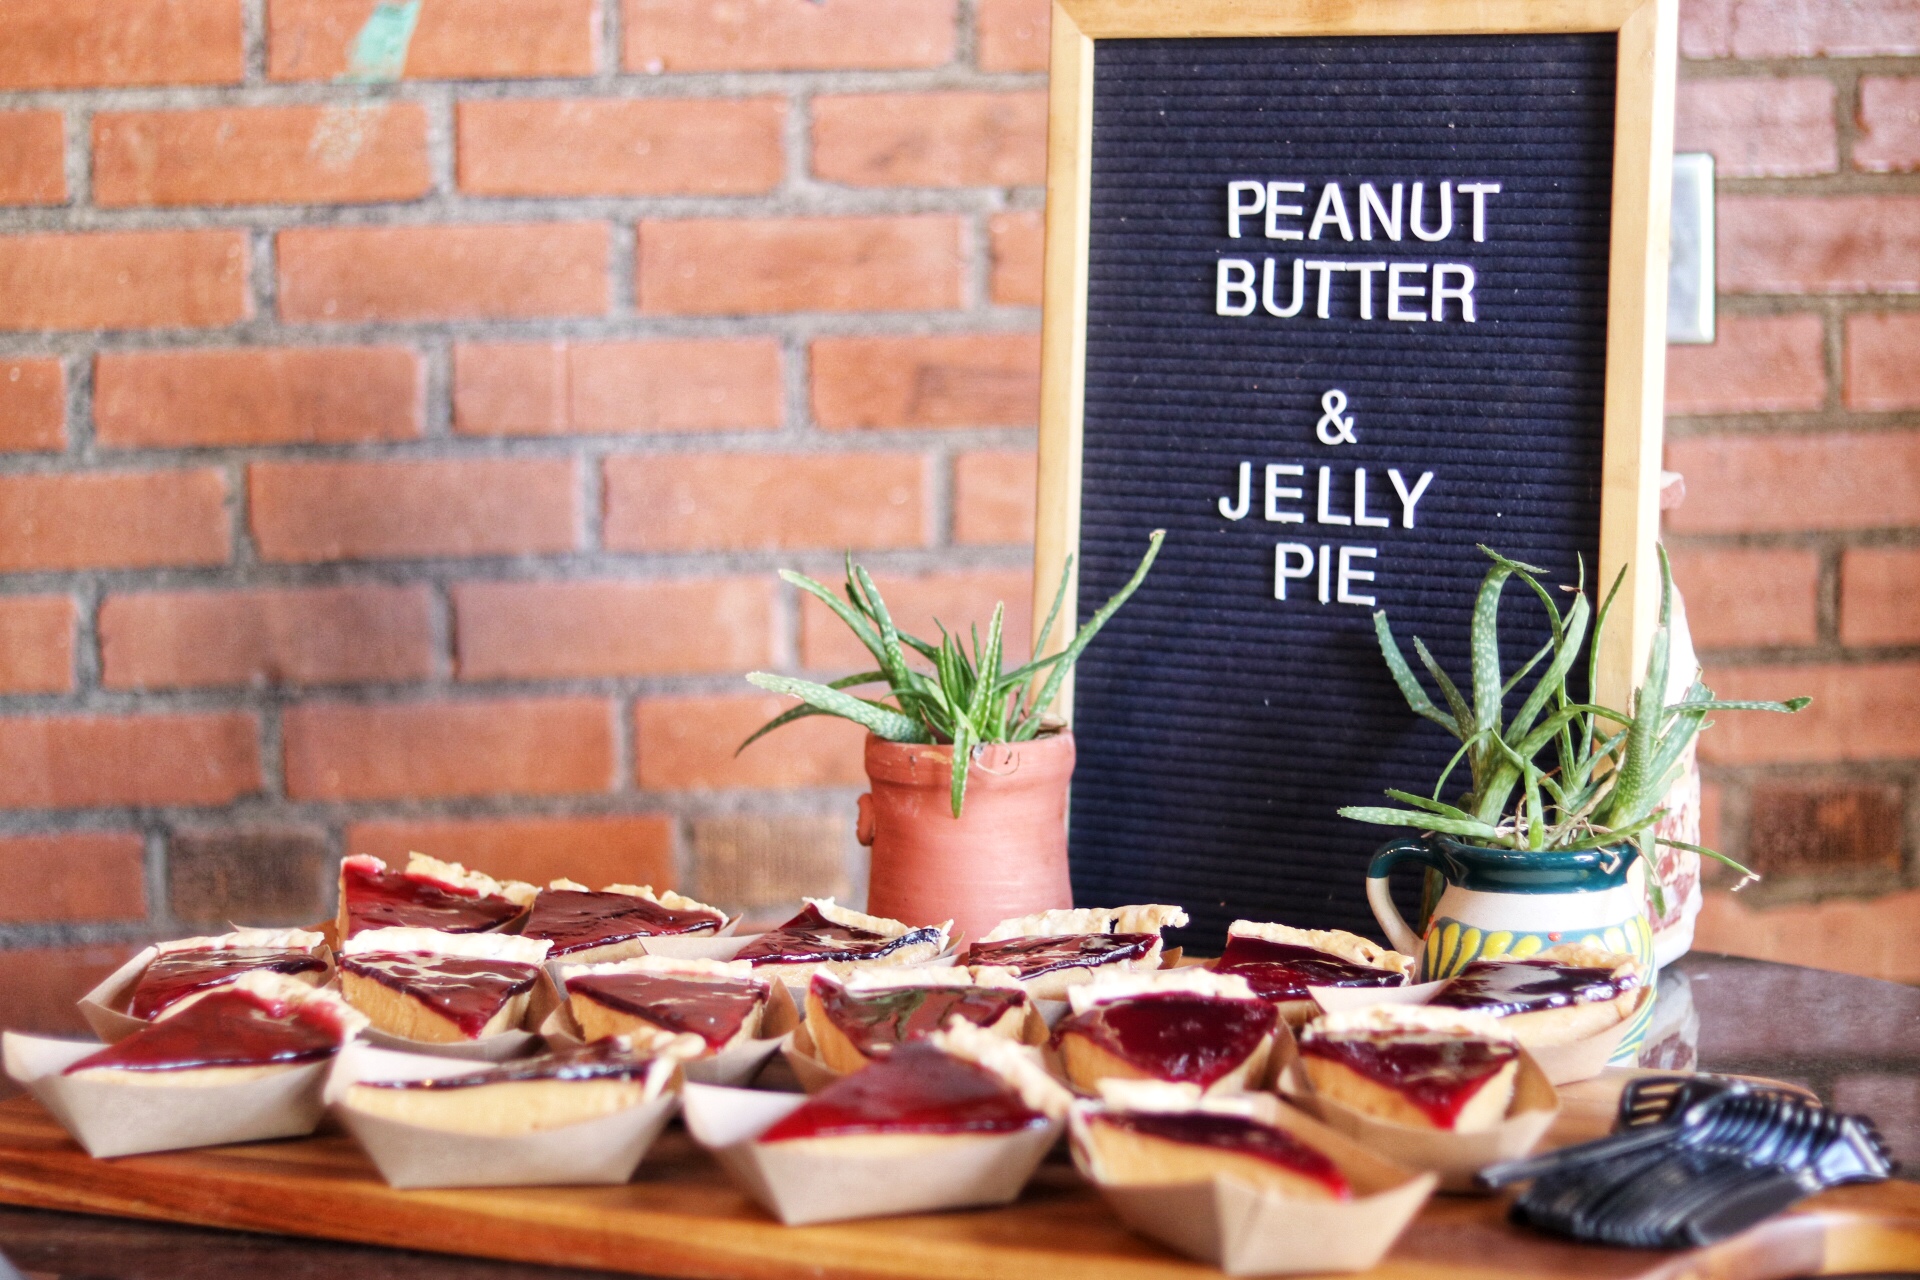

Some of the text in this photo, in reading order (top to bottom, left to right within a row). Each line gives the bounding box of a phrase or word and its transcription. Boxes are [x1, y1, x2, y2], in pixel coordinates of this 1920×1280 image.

[1227, 180, 1501, 243] PEANUT
[1216, 258, 1476, 323] BUTTER
[1316, 389, 1357, 445] &
[1218, 461, 1434, 530] JELLY
[1274, 542, 1378, 607] PIE
